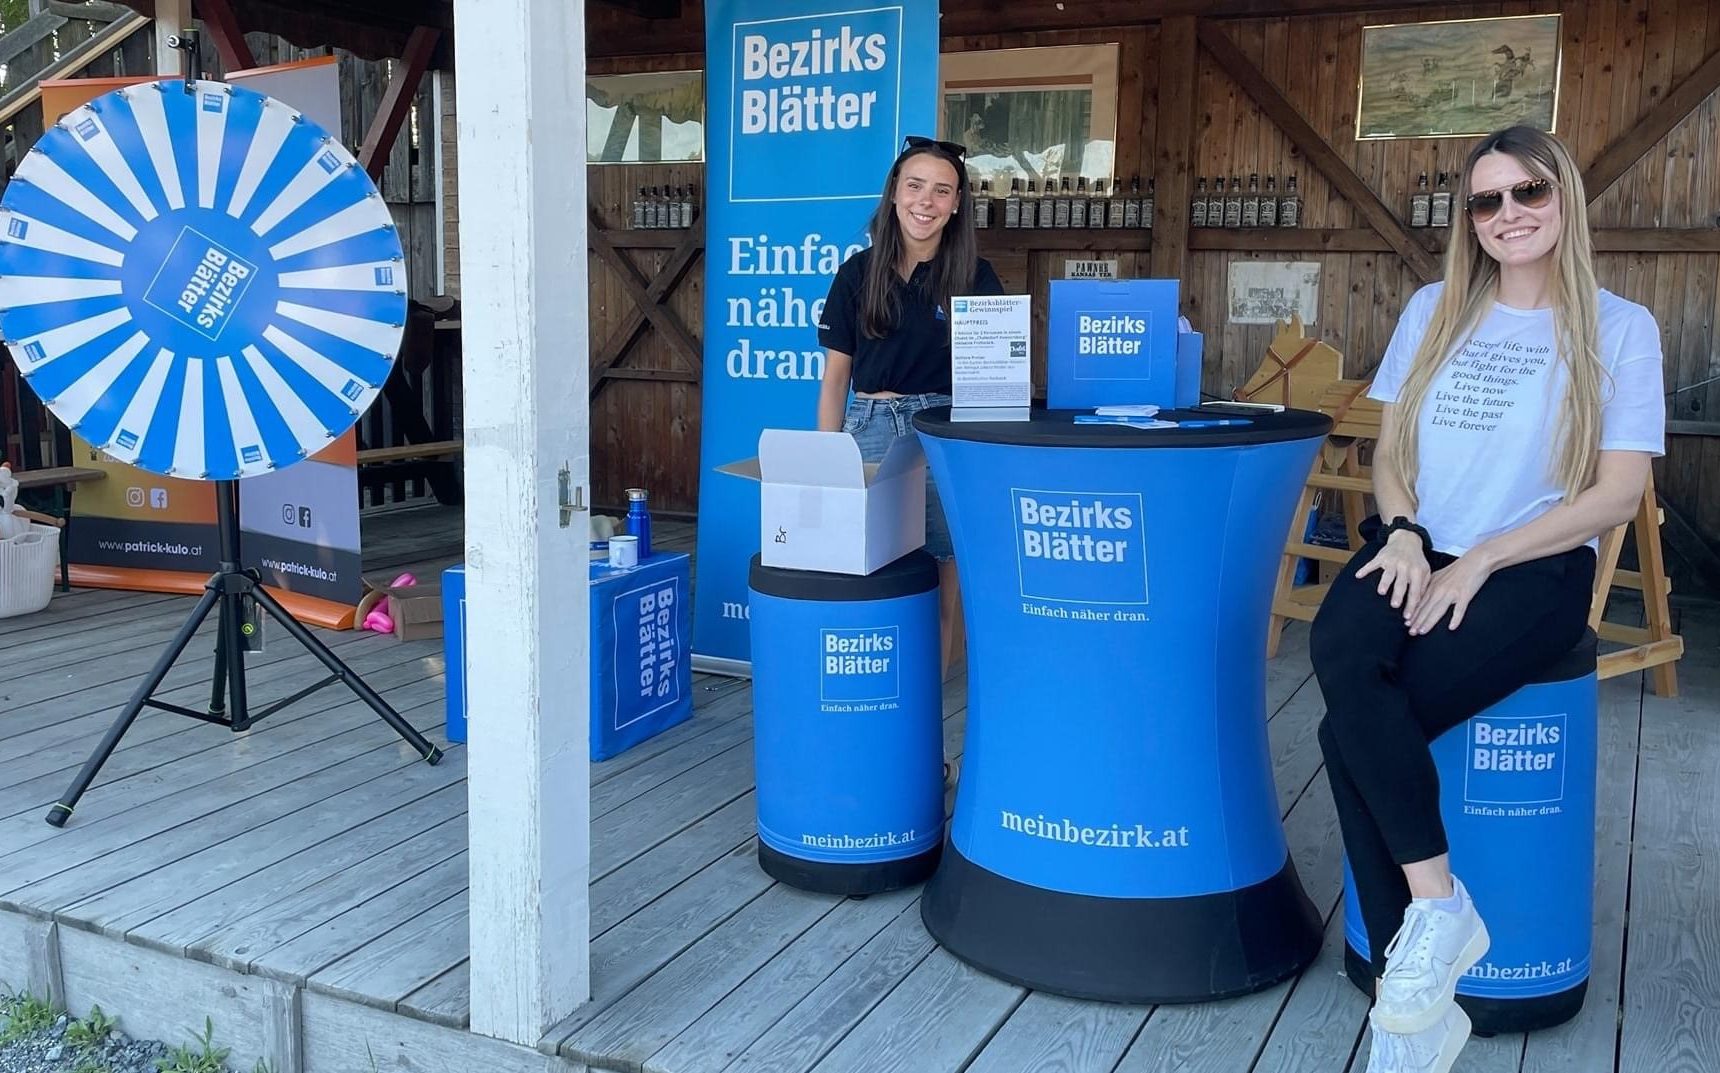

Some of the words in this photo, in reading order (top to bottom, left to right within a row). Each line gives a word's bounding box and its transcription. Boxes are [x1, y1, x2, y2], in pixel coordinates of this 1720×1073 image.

[743, 25, 886, 80] Bezirks
[741, 85, 877, 135] Blätter
[177, 247, 228, 314] Blätter
[197, 260, 250, 329] Bezirks
[1079, 315, 1146, 334] Bezirks
[1079, 336, 1142, 354] Blätter
[1503, 340, 1523, 352] life
[1526, 345, 1550, 354] with
[1451, 358, 1468, 367] but
[1471, 359, 1497, 371] fight
[1500, 365, 1517, 374] for
[1519, 367, 1537, 376] the
[1490, 351, 1521, 364] gives
[1451, 370, 1482, 381] good
[1483, 375, 1519, 386] things.
[1454, 381, 1480, 393] Live
[1482, 387, 1508, 395] now
[1435, 391, 1460, 402] Live
[1462, 395, 1480, 405] the
[1482, 397, 1515, 408] future
[1435, 404, 1460, 415] Live
[1462, 407, 1480, 418] the
[1480, 410, 1504, 421] past
[1432, 416, 1457, 428] Live
[1458, 420, 1498, 432] forever
[1019, 496, 1133, 530] Bezirks
[775, 525, 787, 544] Br
[98, 540, 202, 556] www.patrick-kulo.at
[1023, 529, 1128, 563] Blätter
[261, 557, 337, 582] www.patrick-kulo.at
[1022, 602, 1068, 619] Einfach
[1071, 608, 1111, 621] näher
[1114, 610, 1150, 622] dran.
[639, 592, 657, 697] Blätter
[657, 587, 676, 697] Bezirks
[825, 633, 893, 653] Bezirks
[825, 655, 890, 675] Blätter
[821, 702, 852, 712] Einfach
[853, 703, 878, 712] näher
[879, 702, 900, 711] dran.
[1474, 722, 1560, 746] Bezirks
[1473, 748, 1556, 772] Blätter
[1463, 805, 1505, 817] Einfach
[1507, 807, 1538, 817] näher
[1539, 805, 1562, 815] dran.
[1001, 809, 1189, 848] meinbezirk.at
[802, 829, 916, 849] meinbezirk.at
[1464, 957, 1572, 980] nbezirk.at
